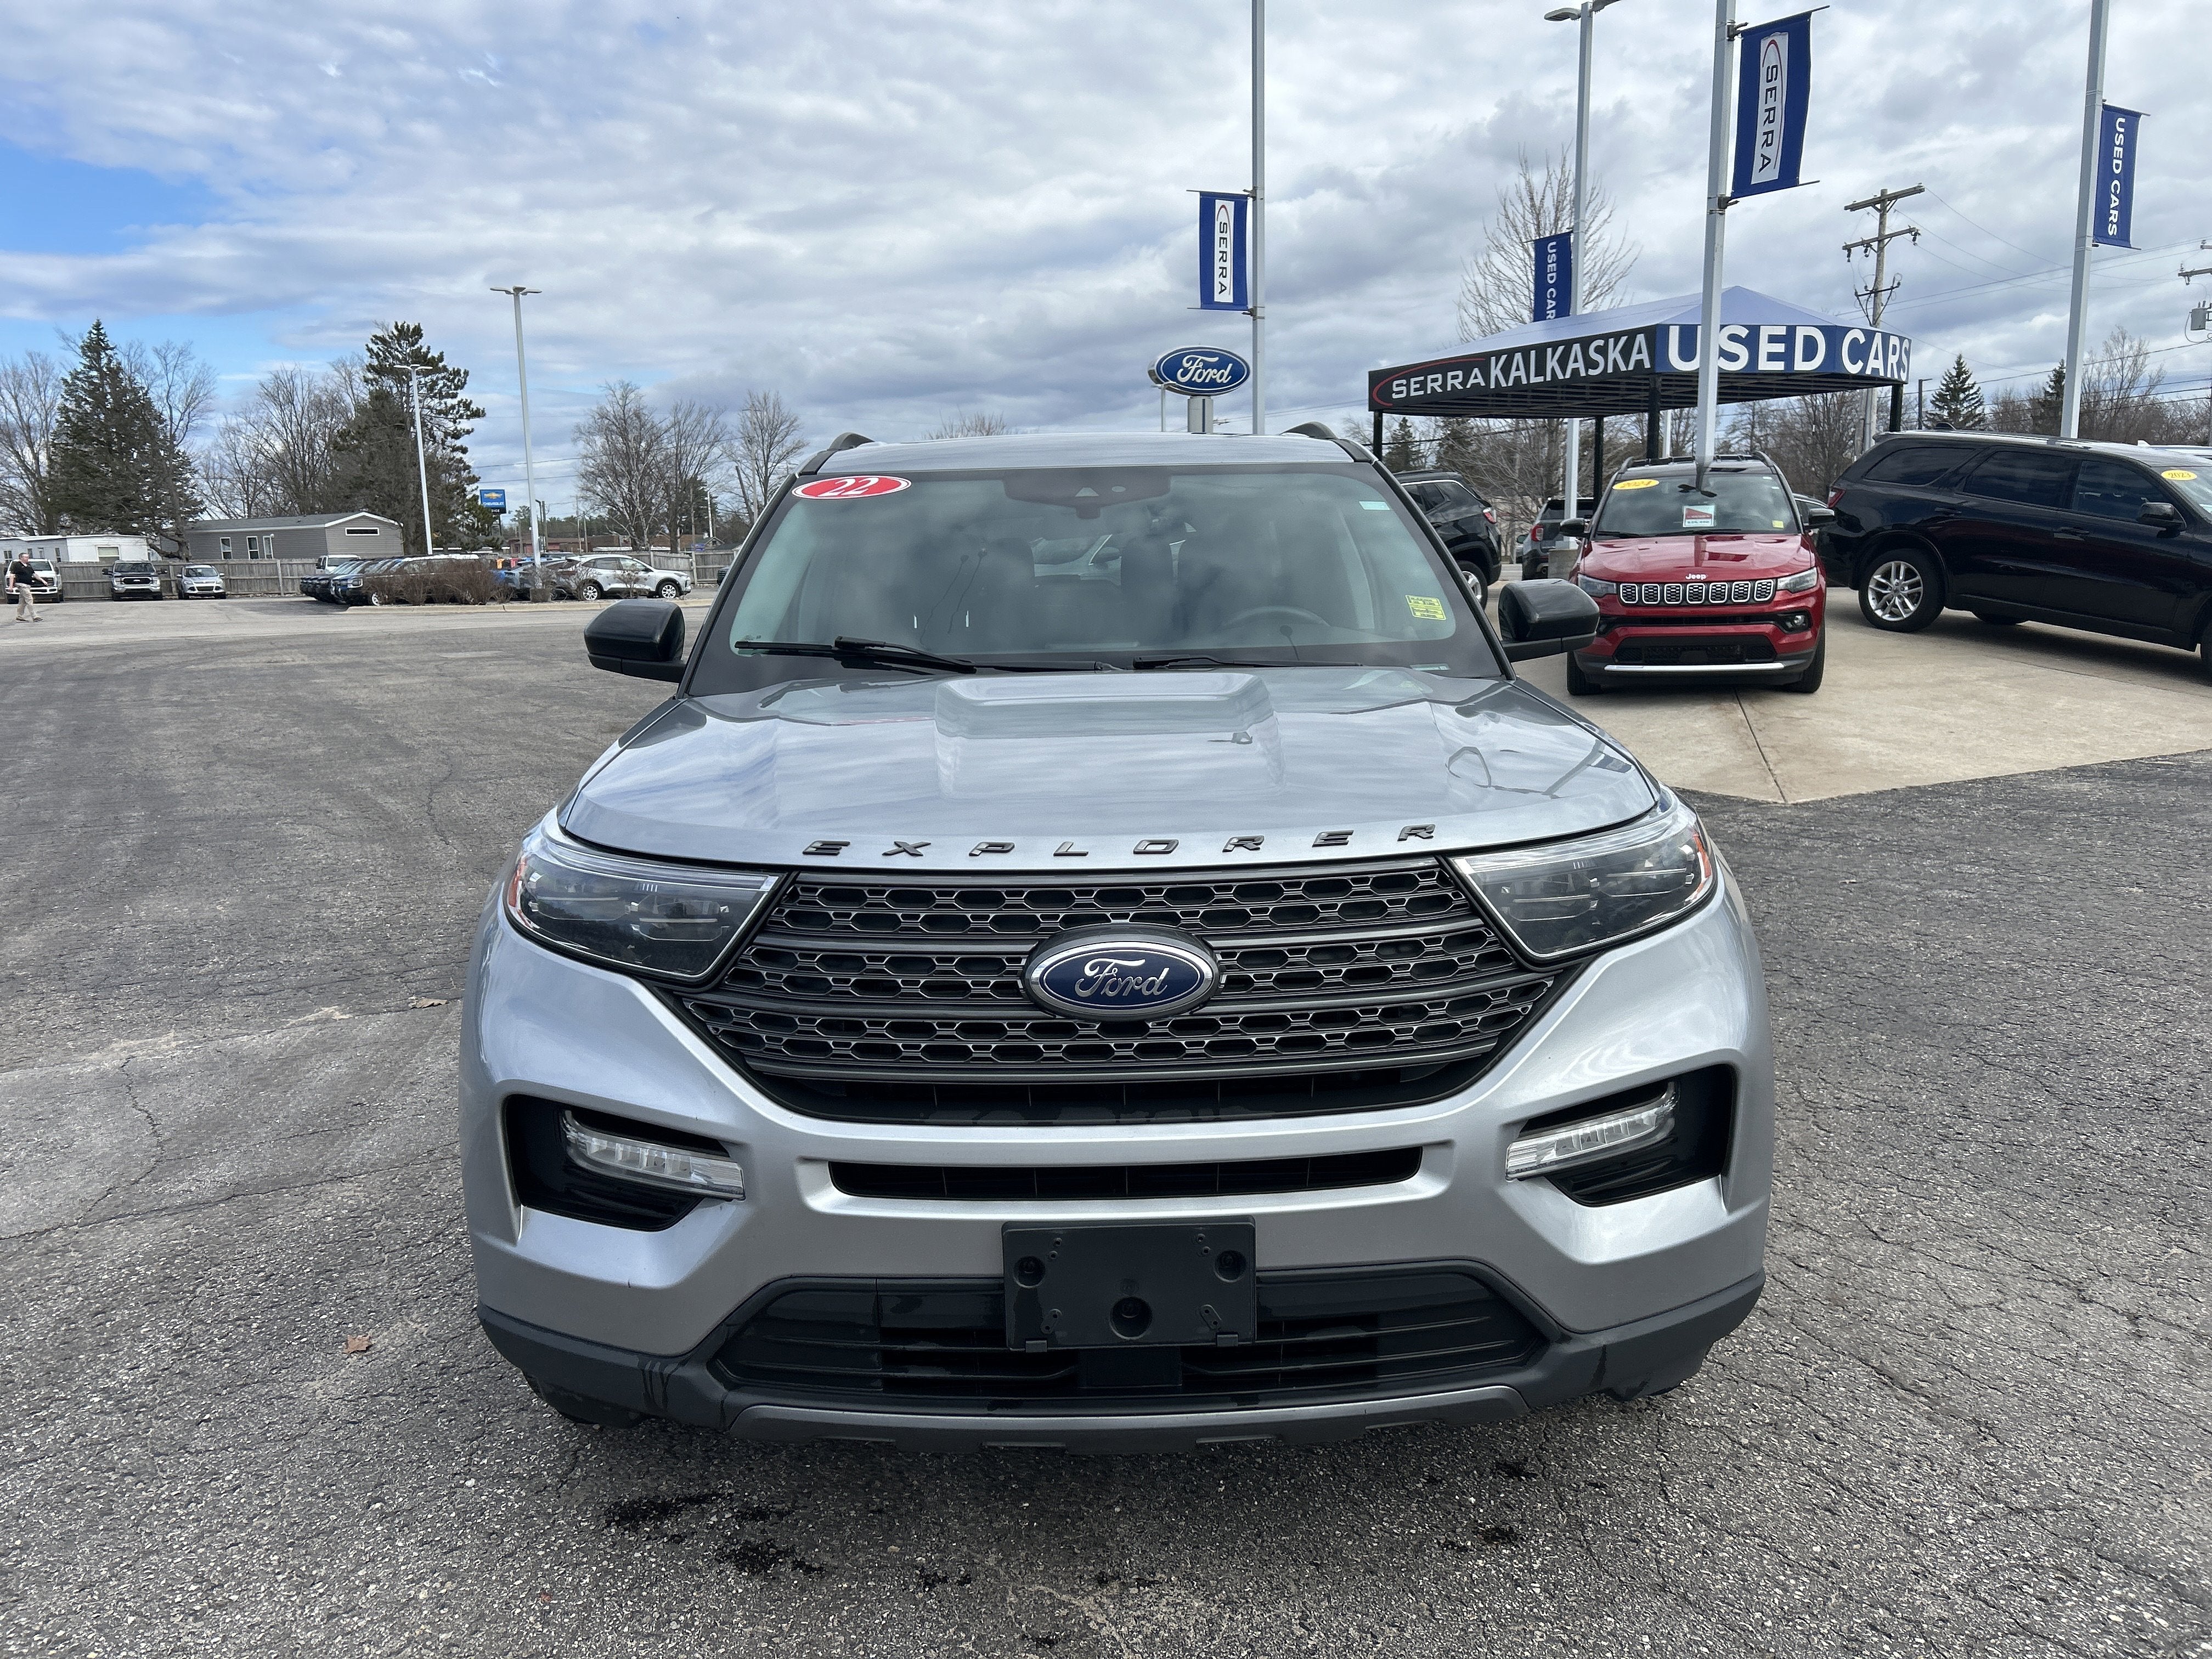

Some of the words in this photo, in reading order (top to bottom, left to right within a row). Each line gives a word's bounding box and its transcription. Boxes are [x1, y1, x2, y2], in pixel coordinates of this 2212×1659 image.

[1758, 64, 1779, 173] SERRA
[2112, 117, 2126, 174] USED
[2108, 179, 2121, 237] CARS
[1218, 221, 1228, 295] SERRA
[1547, 241, 1557, 284] USED
[1546, 287, 1557, 320] CAR
[1176, 354, 1233, 384] Ford
[1392, 367, 1486, 399] SERRA
[1489, 333, 1651, 389] KALKASKA
[1668, 324, 1826, 371] USED
[1842, 329, 1909, 382] CARS
[817, 477, 879, 497] 22
[802, 822, 1437, 857] EXPLORER
[1074, 957, 1170, 997] Ford
